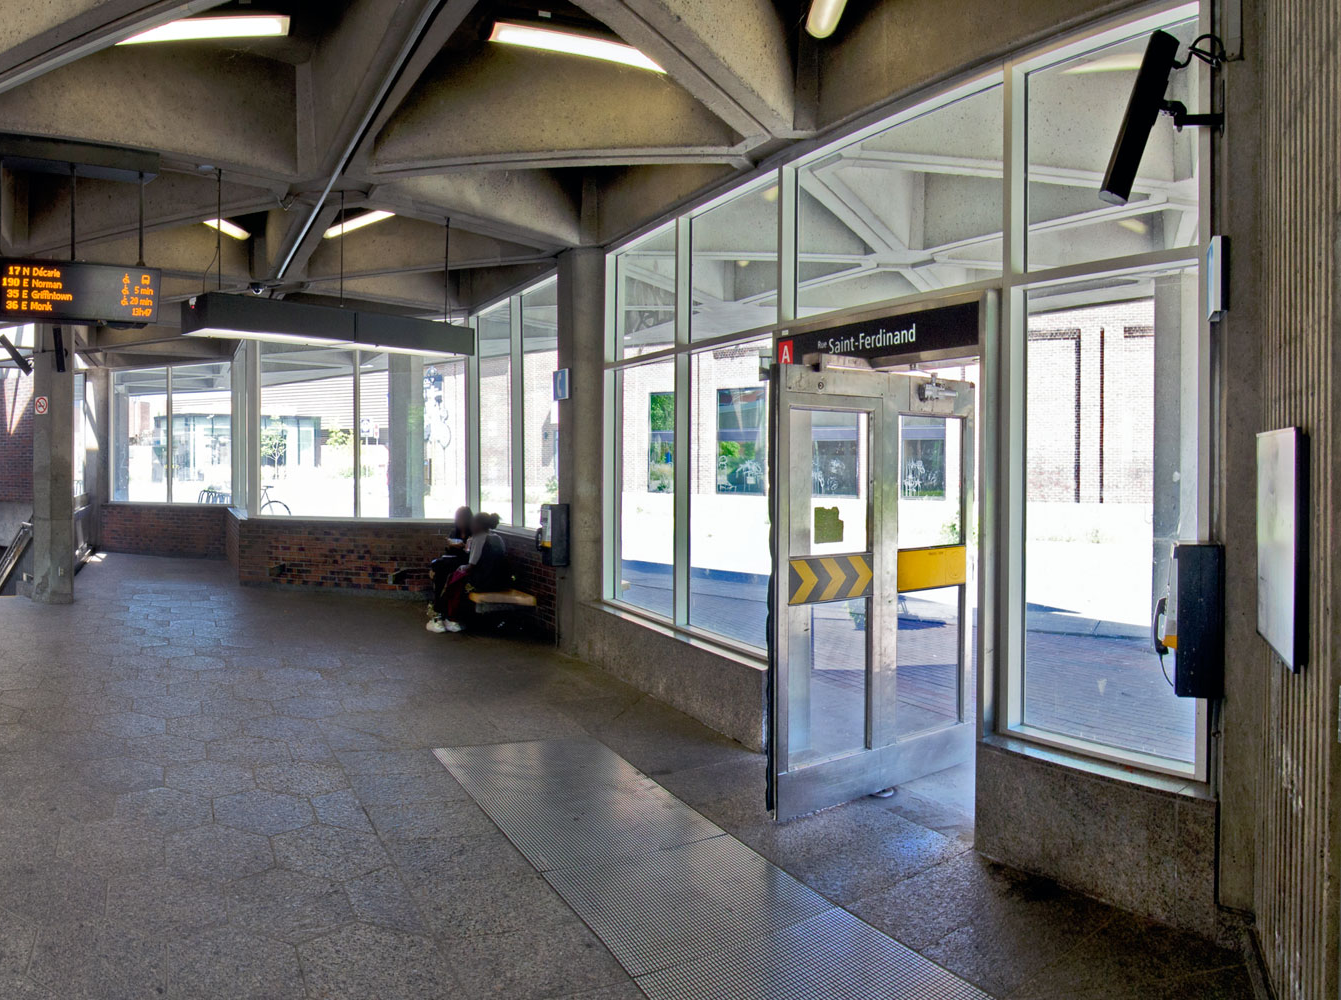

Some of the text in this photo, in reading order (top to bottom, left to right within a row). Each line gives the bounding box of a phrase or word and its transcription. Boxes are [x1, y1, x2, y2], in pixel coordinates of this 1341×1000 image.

[8, 265, 61, 278] 17 N Décarie
[2, 277, 154, 296] 190 E Norman 5 min
[5, 300, 19, 310] 36
[21, 301, 28, 310] E
[30, 301, 53, 311] Monk
[6, 288, 153, 306] 35 E Griffintown 20 min
[781, 323, 917, 363] A Rue Saint-Ferdinand
